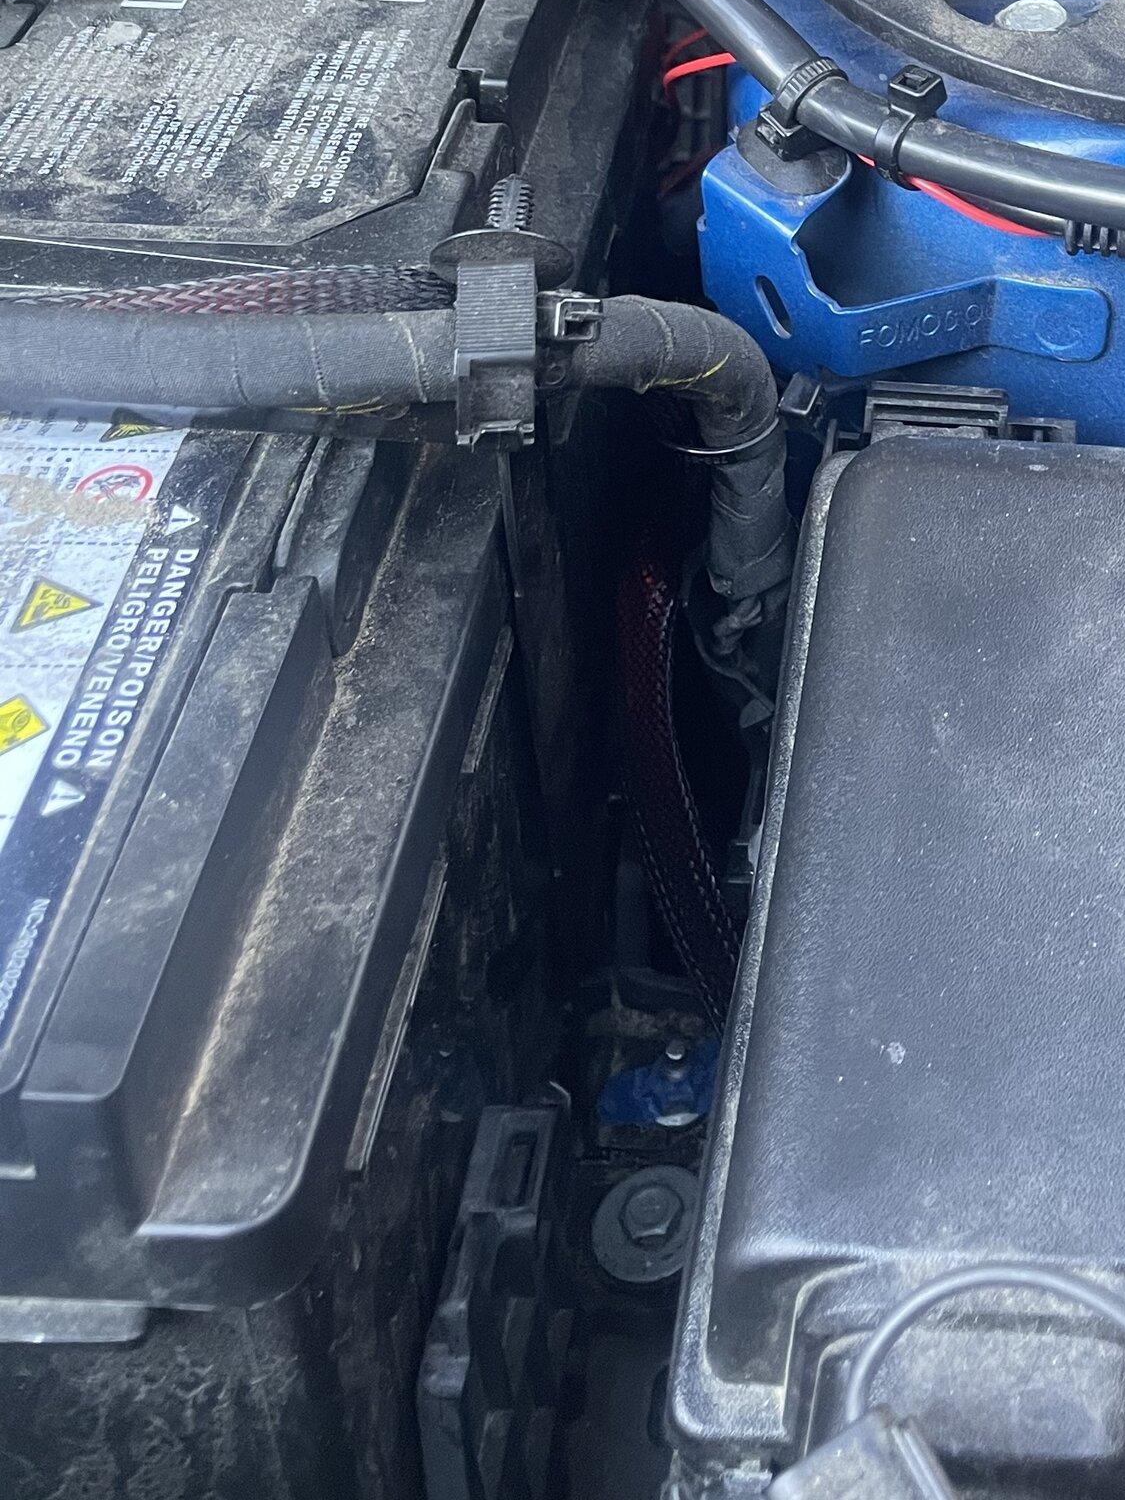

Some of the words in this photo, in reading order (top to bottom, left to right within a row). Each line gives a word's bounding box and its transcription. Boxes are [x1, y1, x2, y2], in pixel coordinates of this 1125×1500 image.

[295, 53, 327, 97] CHARGING
[321, 40, 352, 81] INVERTED
[329, 83, 348, 102] NOT
[356, 72, 372, 85] DO
[229, 94, 255, 124] RIESGO
[289, 105, 320, 145] FOLLOW
[224, 125, 238, 136] DE
[292, 103, 339, 175] RECOMMENDED
[314, 106, 356, 171] DISASSEMBLE
[121, 115, 170, 183] INSTRUCCIONES
[155, 152, 179, 177] COMO
[191, 155, 206, 168] NO
[269, 146, 299, 185] PROPER
[325, 132, 363, 187] EXPLOSION
[173, 160, 189, 173] NO
[306, 173, 324, 188] OR
[281, 178, 302, 198] FOR
[318, 188, 337, 203] OR
[52, 548, 169, 769] PELIGRO/VENENO
[87, 547, 199, 768] DANGER/POISON
